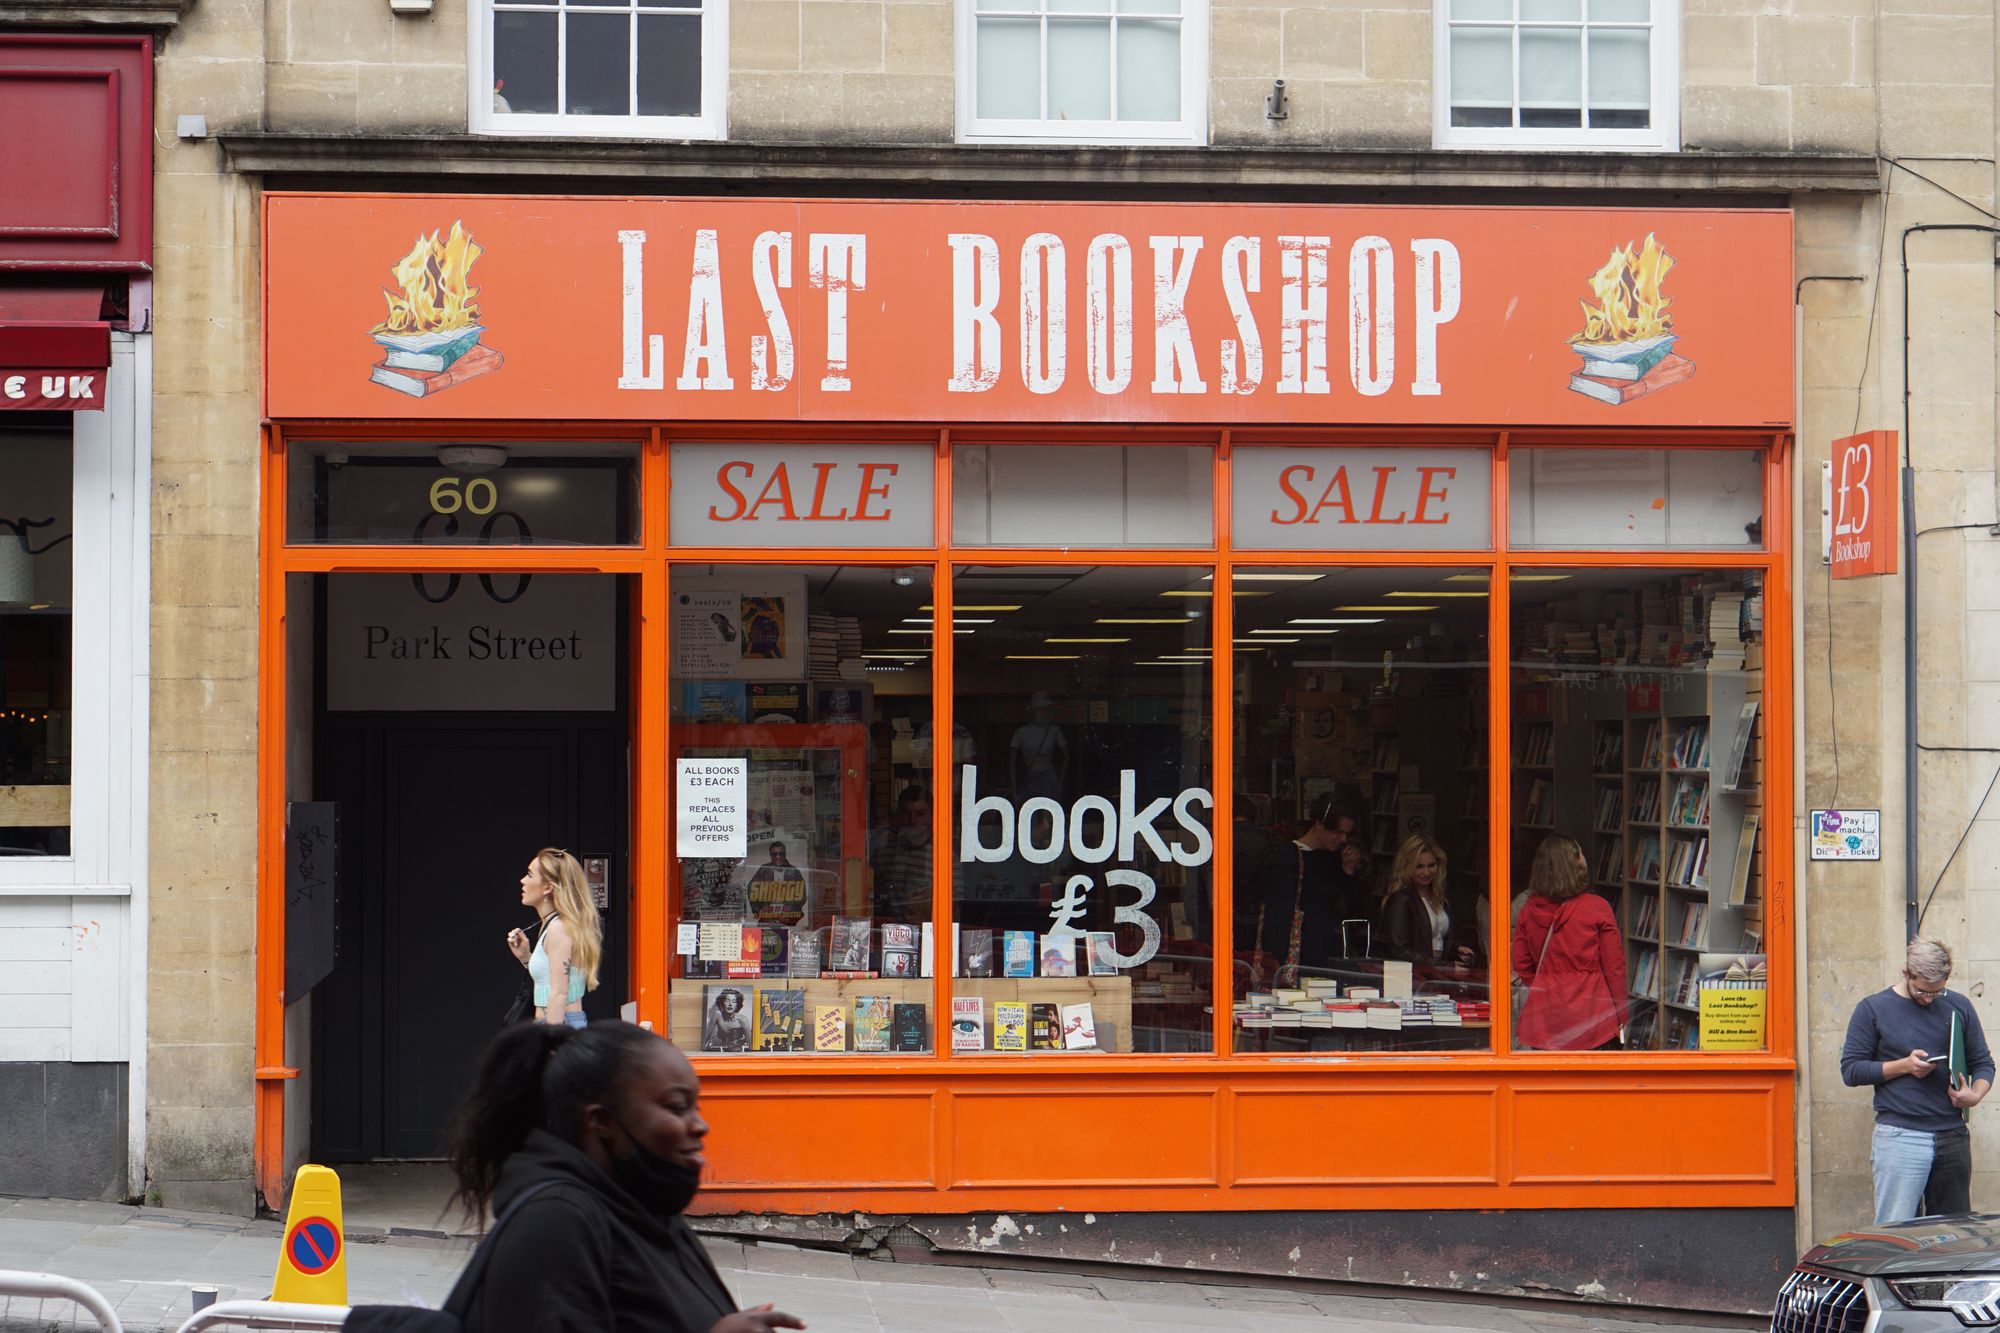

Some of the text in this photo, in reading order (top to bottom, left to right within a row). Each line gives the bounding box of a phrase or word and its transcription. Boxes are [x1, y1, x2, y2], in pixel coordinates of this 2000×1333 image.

[616, 228, 1462, 397] LAST BOOKSHOP
[41, 375, 95, 400] UK
[429, 477, 498, 515] 60
[707, 460, 899, 523] SALE
[1269, 465, 1457, 526] SALE
[1836, 443, 1871, 535] £3
[1835, 537, 1871, 563] Bookshop
[363, 625, 583, 661] Park Street
[684, 767, 740, 775] ALL BOOKS
[690, 777, 734, 786] £3 EACH
[689, 805, 736, 813] REPLACES
[959, 763, 1214, 868] books
[702, 815, 719, 823] ALL
[1844, 817, 1860, 825] Pay
[690, 824, 735, 832] PREVIOUS
[694, 834, 730, 842] OFFERS
[1850, 848, 1876, 856] ticket
[749, 879, 805, 903] SHAGGY
[1046, 867, 1162, 969] £3
[762, 935, 778, 945] AVE
[887, 927, 910, 938] VIDEO
[953, 1001, 980, 1012] HALF LIVES
[820, 1007, 841, 1022] LOST
